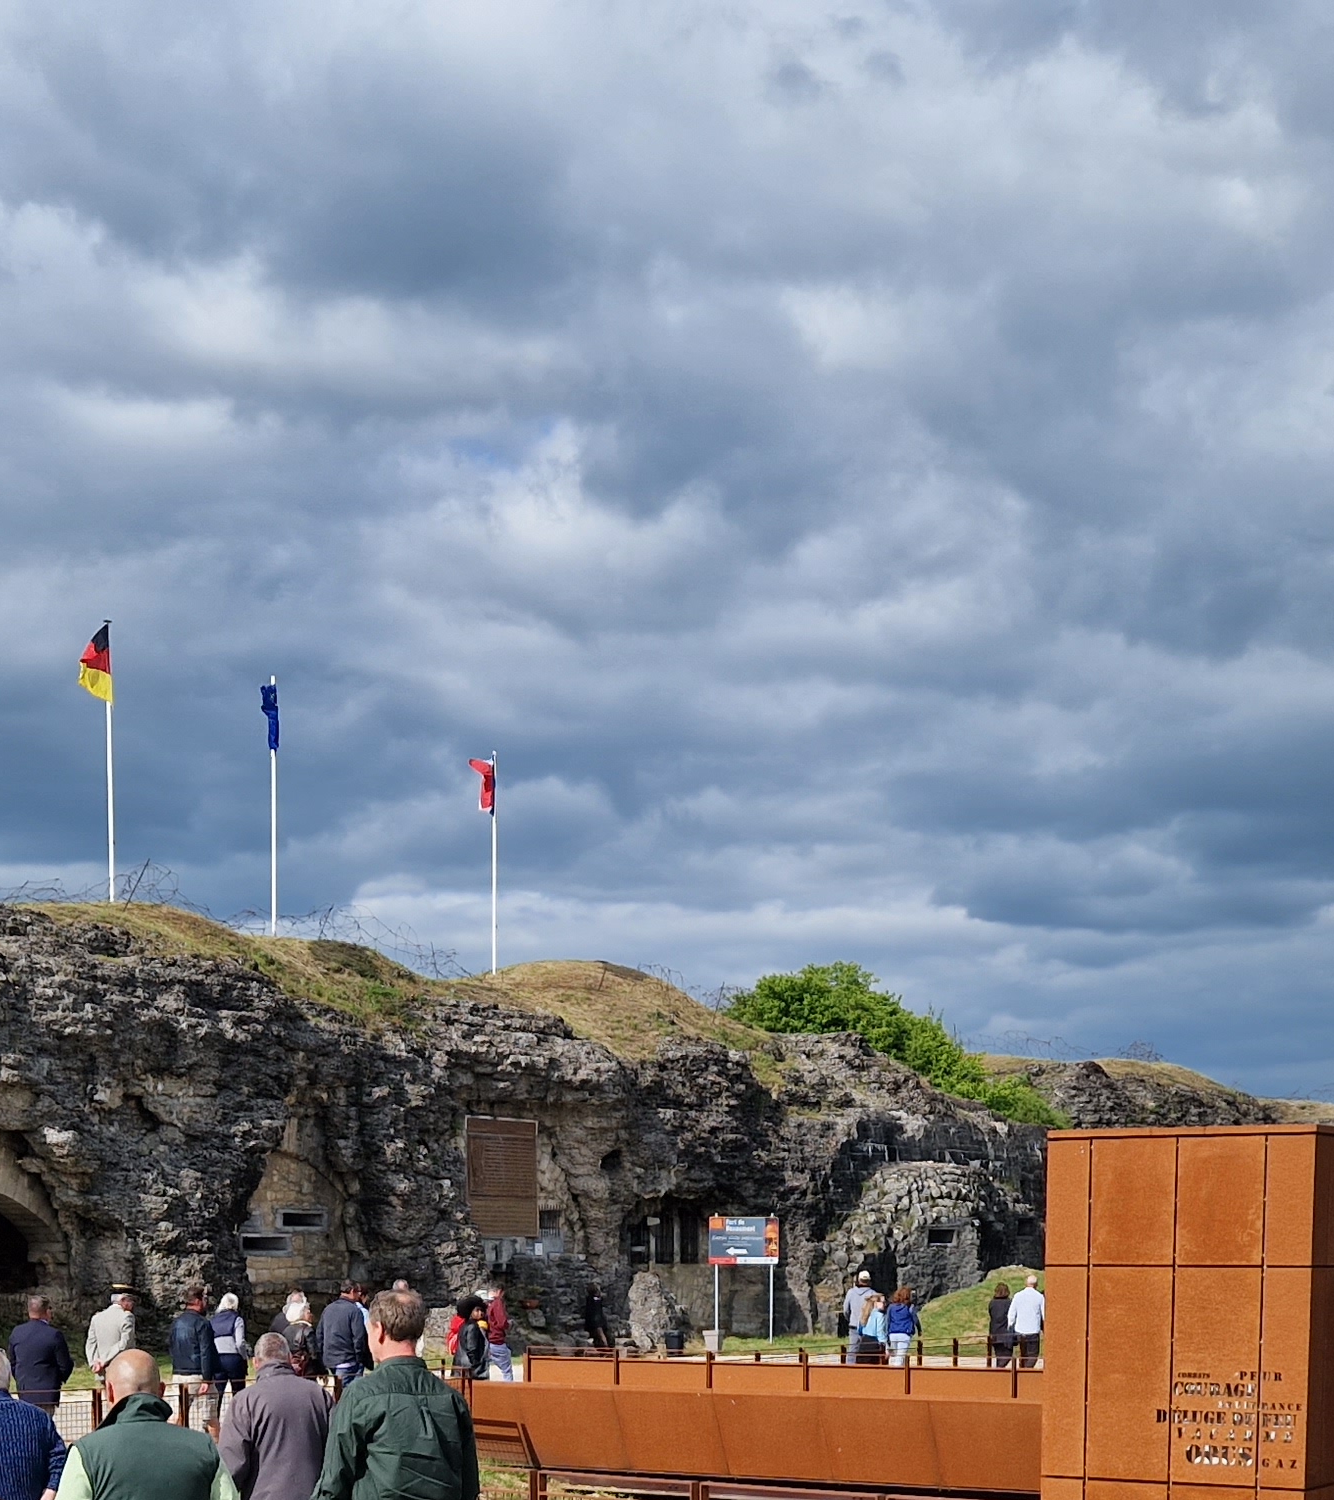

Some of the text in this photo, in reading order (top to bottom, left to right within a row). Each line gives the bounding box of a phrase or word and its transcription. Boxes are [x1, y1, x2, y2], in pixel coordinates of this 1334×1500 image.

[1239, 1370, 1283, 1382] PEUR
[1173, 1380, 1257, 1398] COURAGE
[1155, 1405, 1297, 1430] DÉLUGE DE FEU
[1176, 1426, 1294, 1444] VACARME
[1185, 1443, 1254, 1468] OBUS
[1261, 1457, 1299, 1470] GAZ
